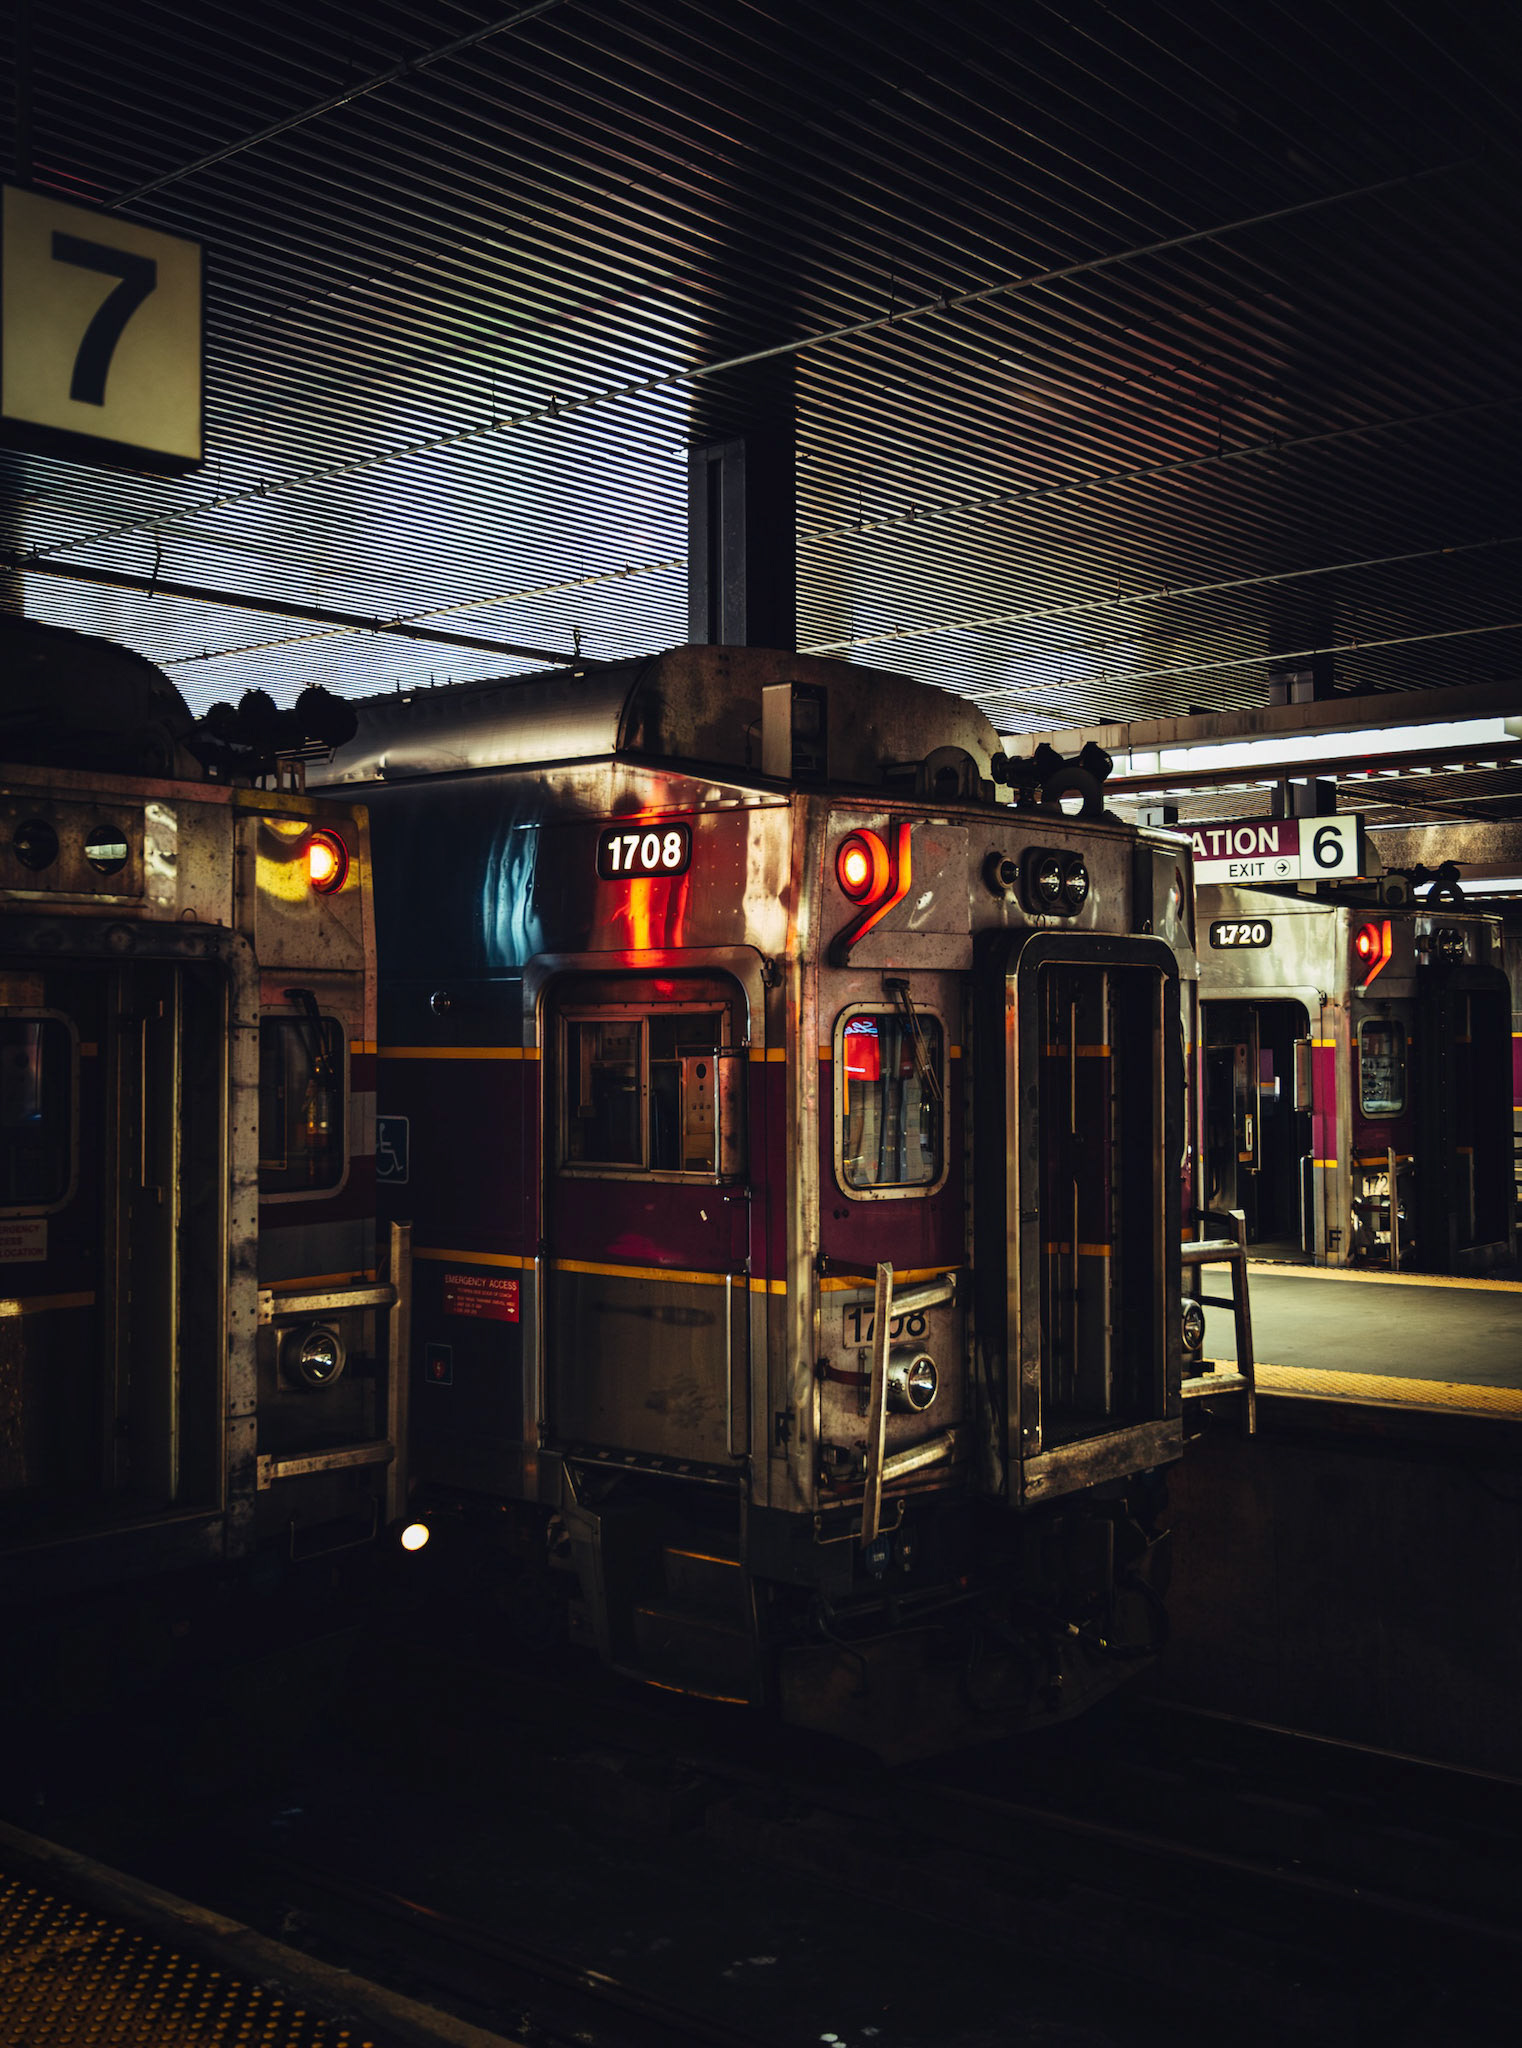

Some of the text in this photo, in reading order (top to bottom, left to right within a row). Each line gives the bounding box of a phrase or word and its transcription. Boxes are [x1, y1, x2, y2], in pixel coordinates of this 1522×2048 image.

[52, 230, 157, 407] 7
[608, 832, 681, 871] 1708
[1192, 826, 1280, 857] ATION
[1314, 826, 1343, 868] 6
[1229, 863, 1265, 877] EXIT
[1216, 924, 1266, 945] 1720
[1365, 1175, 1389, 1195] 172
[444, 1274, 518, 1291] EMERGENCY ACCESS
